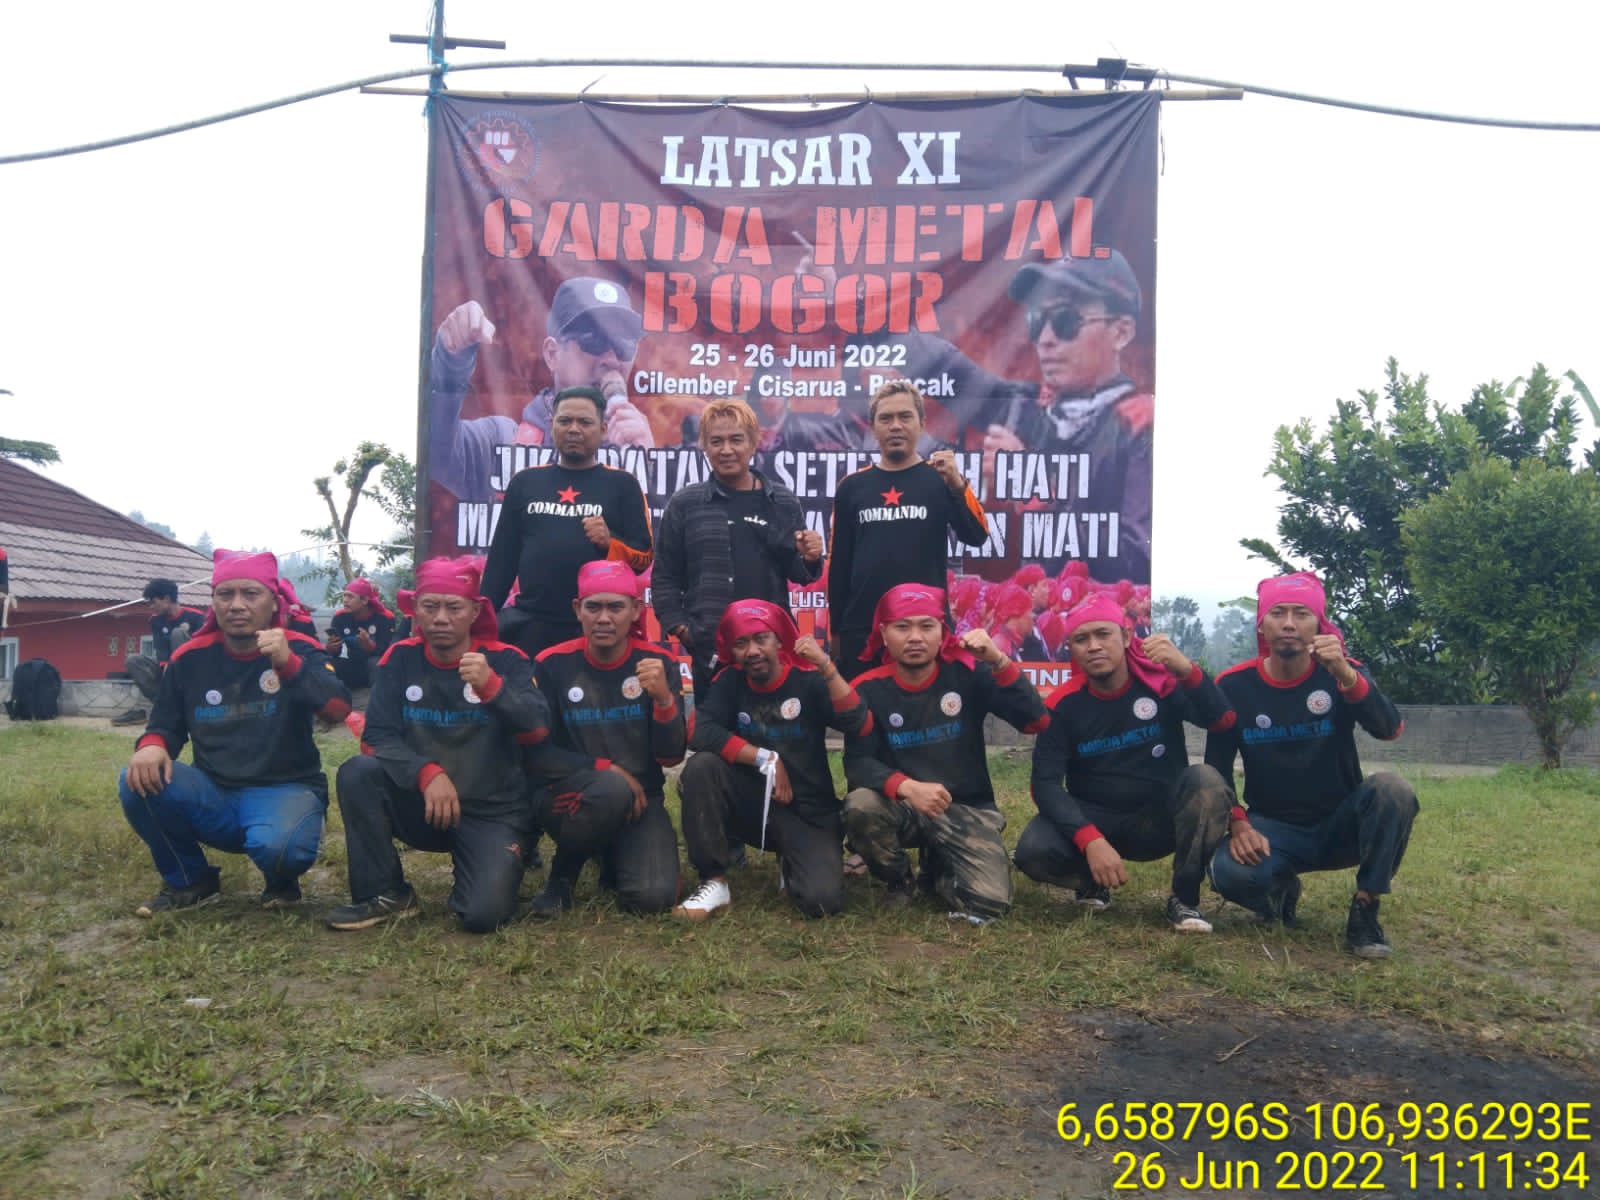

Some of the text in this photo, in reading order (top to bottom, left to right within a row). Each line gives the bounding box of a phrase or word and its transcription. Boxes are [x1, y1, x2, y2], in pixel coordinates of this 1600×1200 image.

[660, 131, 961, 187] LATSAR XI
[484, 196, 1110, 265] GARDA METAL
[643, 271, 944, 334] BOGOR
[689, 343, 721, 367] 25
[743, 344, 774, 367] 26
[783, 344, 836, 368] Juni
[844, 344, 907, 367] 2022
[633, 370, 737, 397] Cilember
[758, 375, 846, 397] Cisarua
[869, 372, 955, 397] Pcak
[996, 452, 1090, 499] HATI
[527, 501, 603, 518] COMMANDO
[858, 504, 928, 525] COMMANDO
[1022, 511, 1120, 559] MATI
